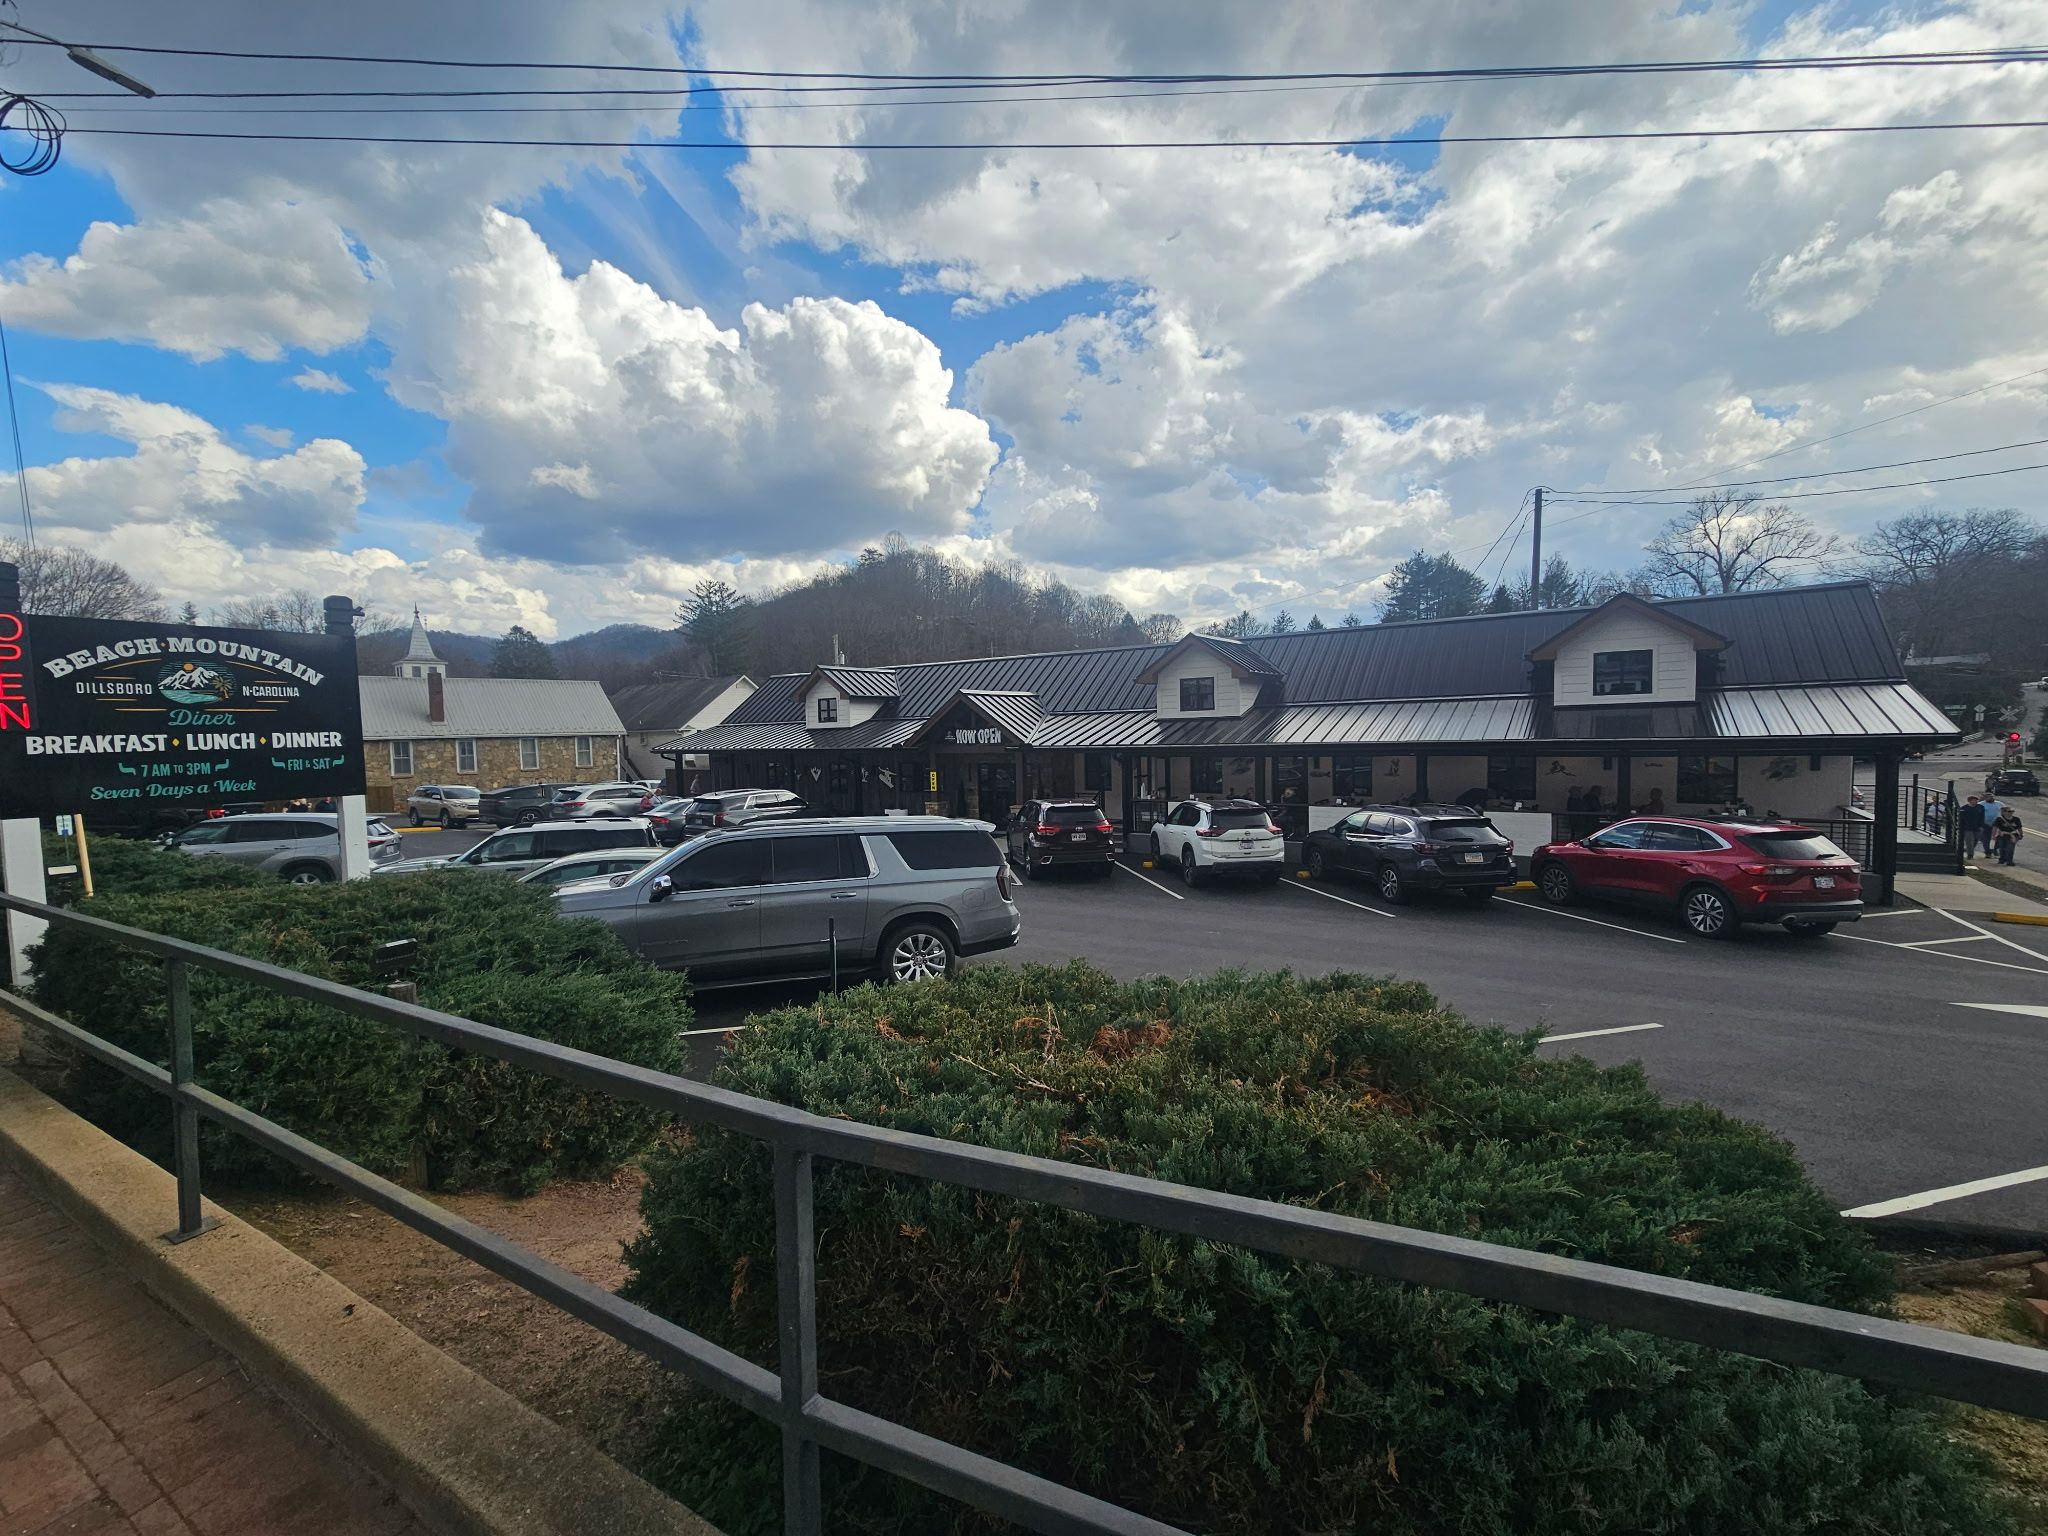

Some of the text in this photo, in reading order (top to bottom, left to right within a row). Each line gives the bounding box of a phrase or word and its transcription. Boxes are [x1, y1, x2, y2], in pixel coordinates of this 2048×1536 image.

[43, 637, 324, 686] BEACH MOUNTAIN
[0, 613, 30, 729] OPEN
[76, 682, 152, 694] DILLSBORO
[168, 709, 235, 726] Diner
[26, 732, 342, 755] BREAKFAST LUNCH DINNER
[956, 729, 976, 744] NOW
[978, 727, 1001, 744] OPEN
[141, 764, 148, 777] 7
[151, 763, 170, 777] AM
[186, 762, 211, 775] 3PM
[287, 757, 331, 771] FRI & SAT
[90, 779, 256, 800] Seven Days a Week
